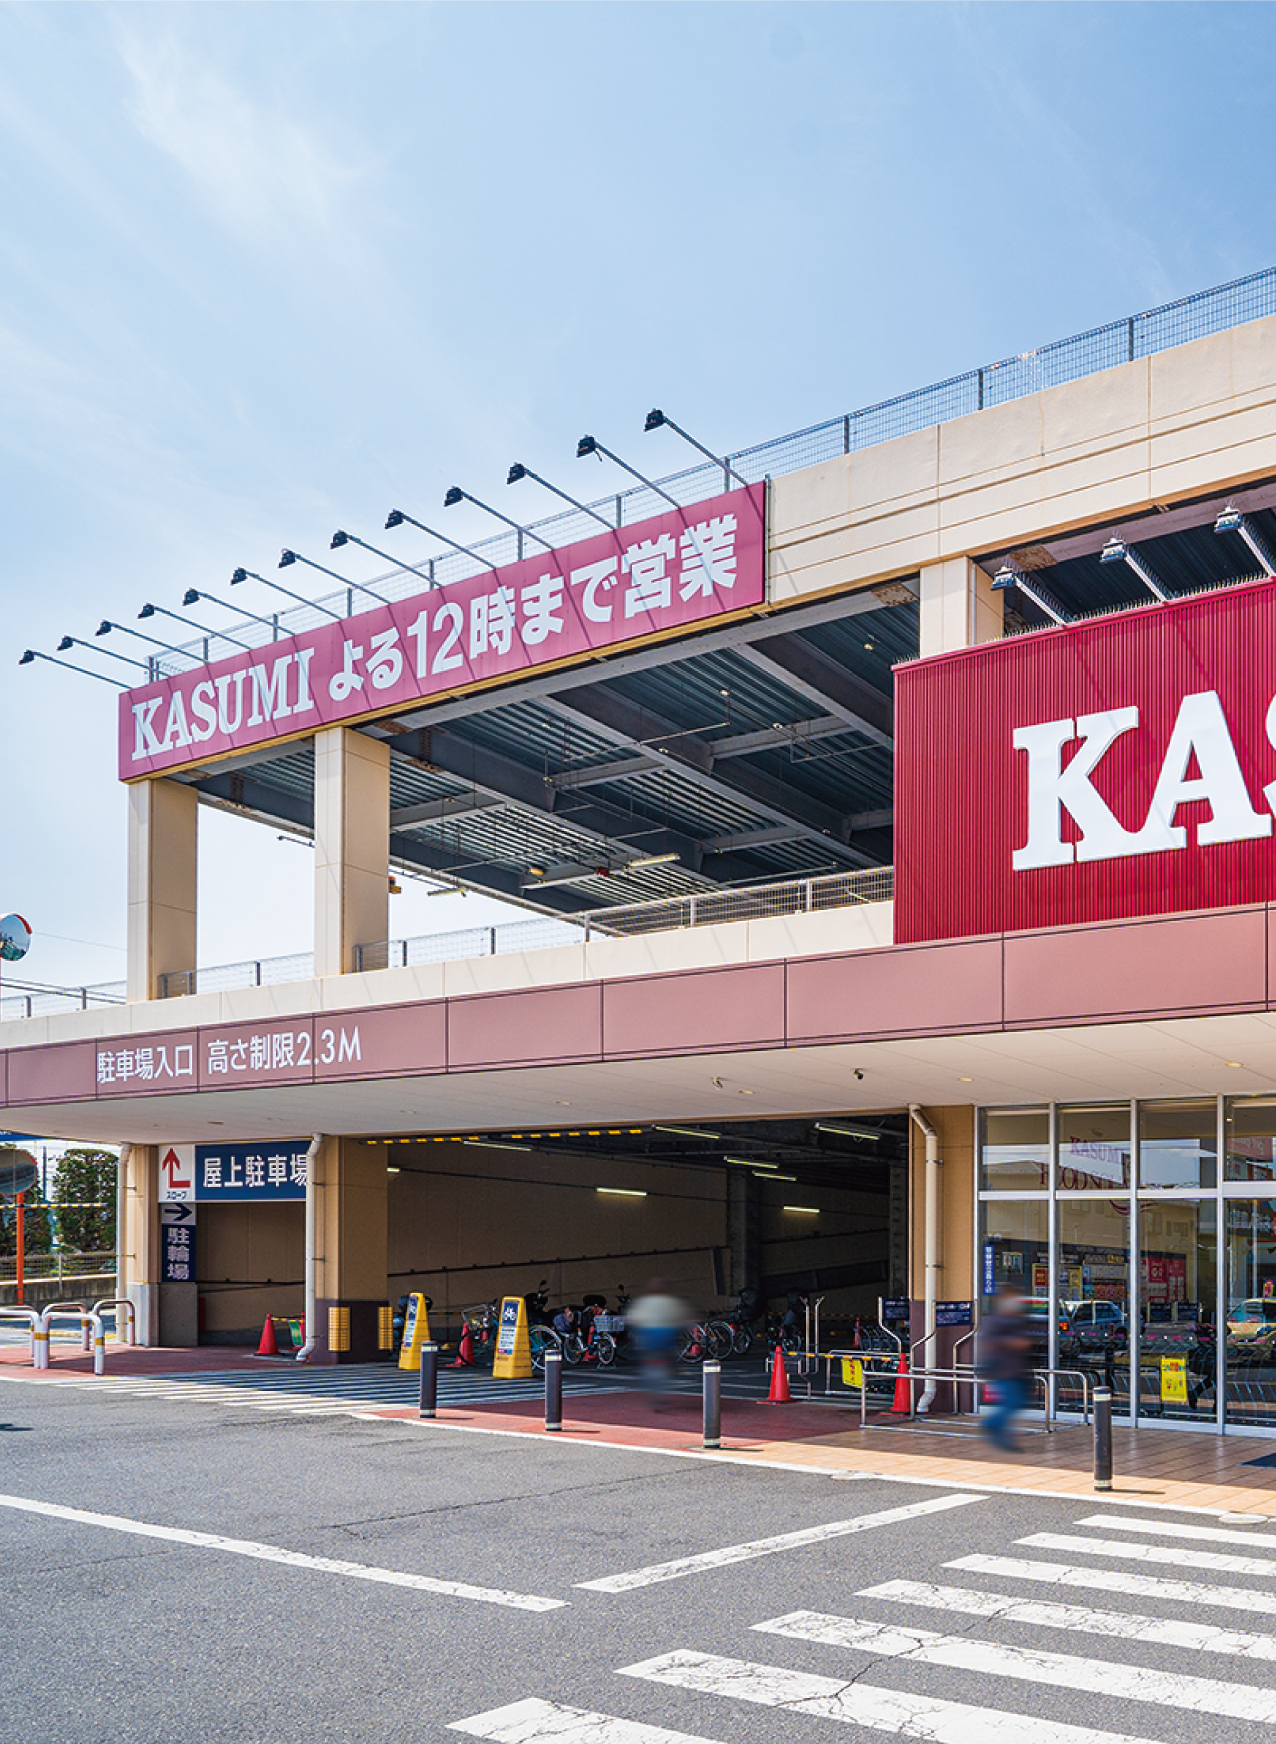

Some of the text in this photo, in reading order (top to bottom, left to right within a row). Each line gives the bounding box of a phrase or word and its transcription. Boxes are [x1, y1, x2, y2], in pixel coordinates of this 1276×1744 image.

[131, 512, 738, 761] KASUMI よる12時まで営業
[96, 1025, 362, 1085] 駐車場入口 高さ制限2.3M
[203, 1153, 307, 1188] 屋上駐車場
[167, 1227, 190, 1280] 駐輪場
